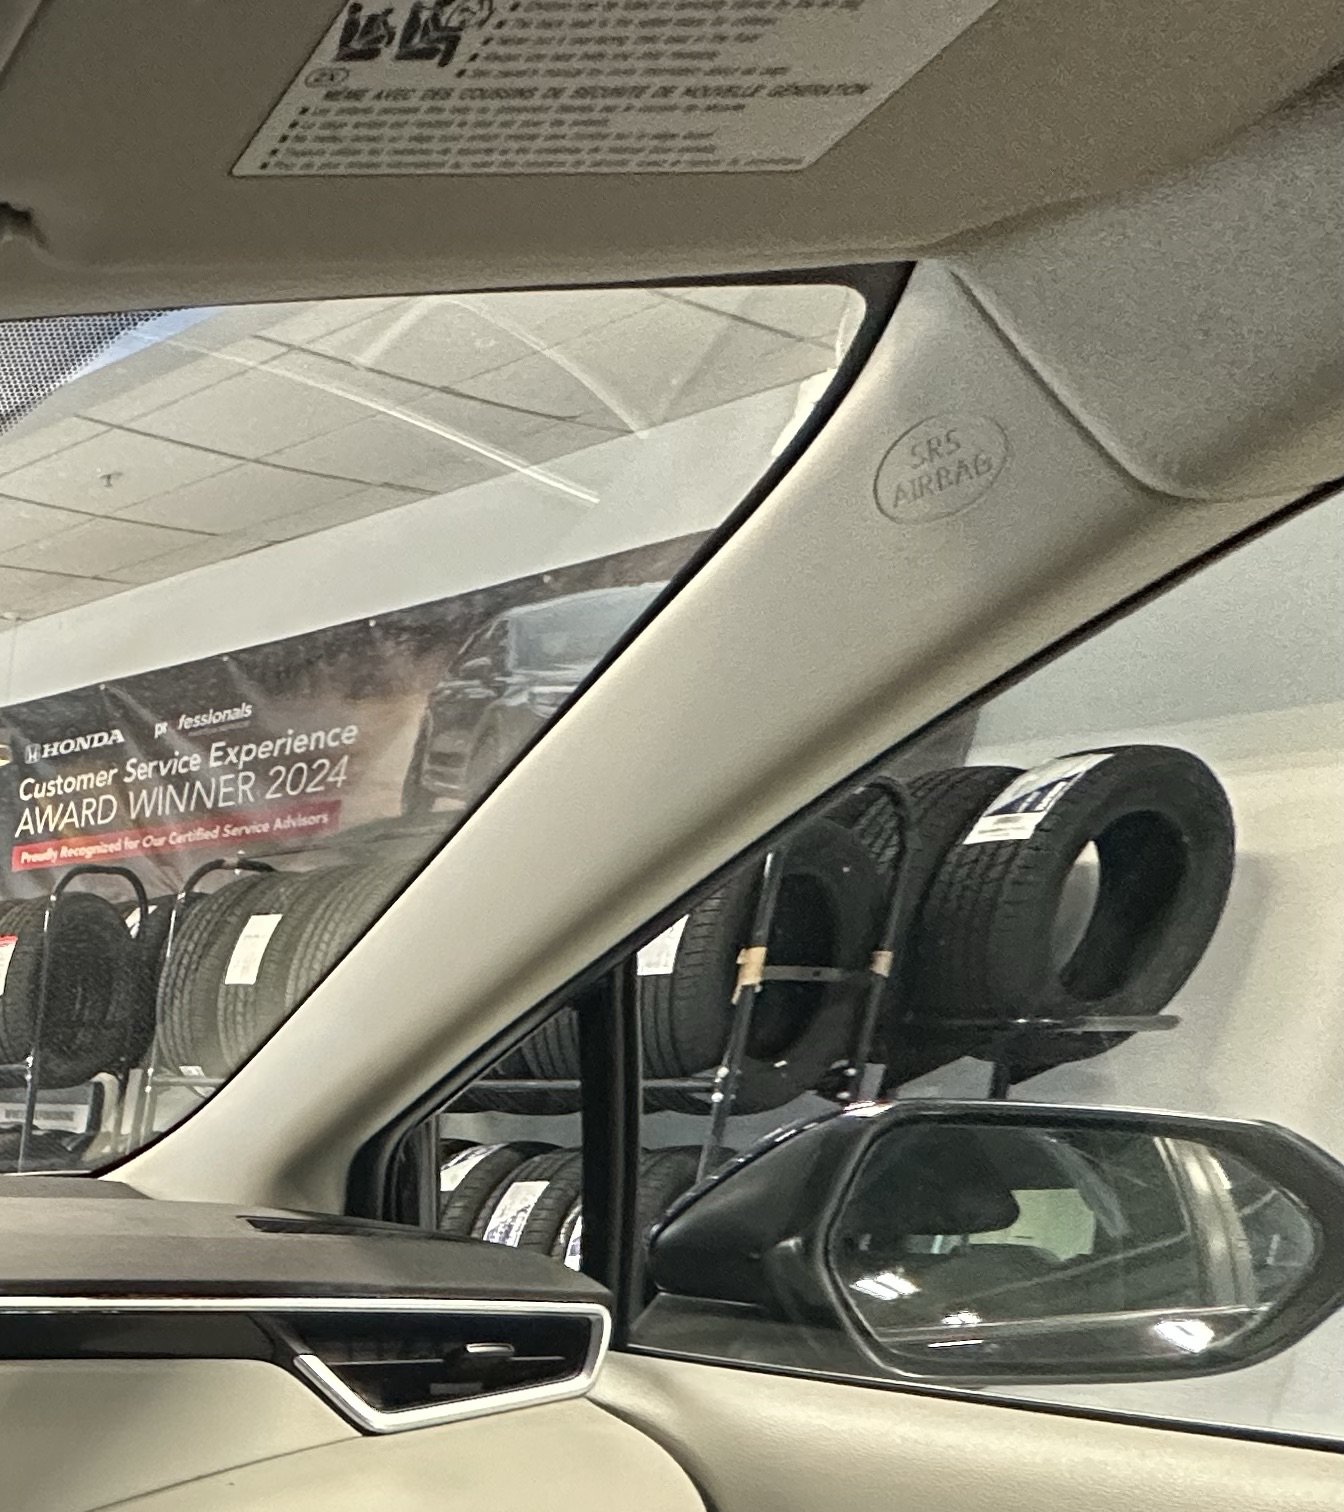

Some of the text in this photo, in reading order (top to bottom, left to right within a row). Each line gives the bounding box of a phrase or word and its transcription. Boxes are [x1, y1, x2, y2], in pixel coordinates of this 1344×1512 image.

[910, 428, 962, 470] SRS
[892, 450, 993, 509] AIRBAG
[19, 724, 359, 802] Customer Service Experience
[41, 728, 125, 759] HONDA
[14, 754, 349, 838] AWARD WINNER 2024
[20, 812, 329, 865] Proudly Recognized for Our Certified Service Advisors
